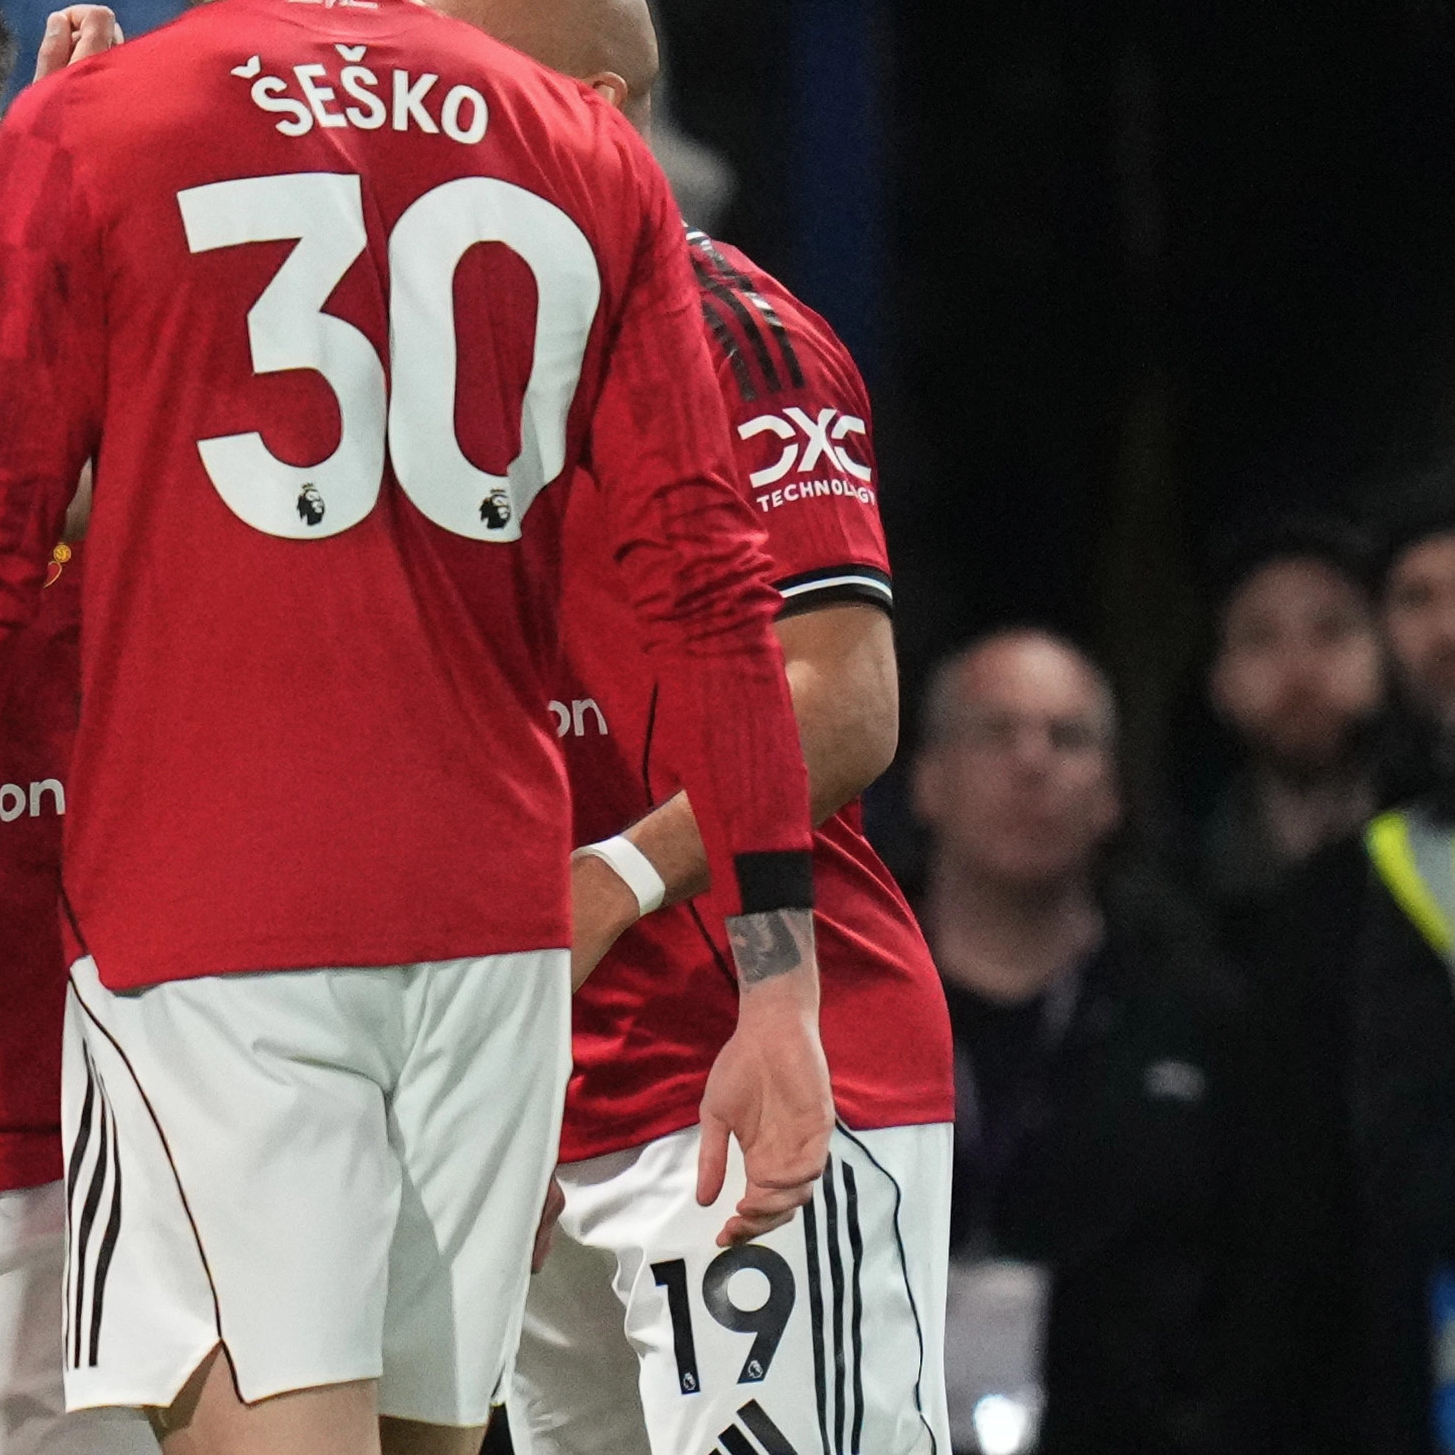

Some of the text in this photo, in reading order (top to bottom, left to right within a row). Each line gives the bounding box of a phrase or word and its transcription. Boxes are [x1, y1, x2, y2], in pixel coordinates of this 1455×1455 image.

[230, 44, 489, 145] ŠEŠKO
[176, 171, 602, 543] 30
[737, 407, 872, 488] DXC
[756, 479, 876, 513] TECHNOLGY
[650, 1244, 796, 1395] 19
